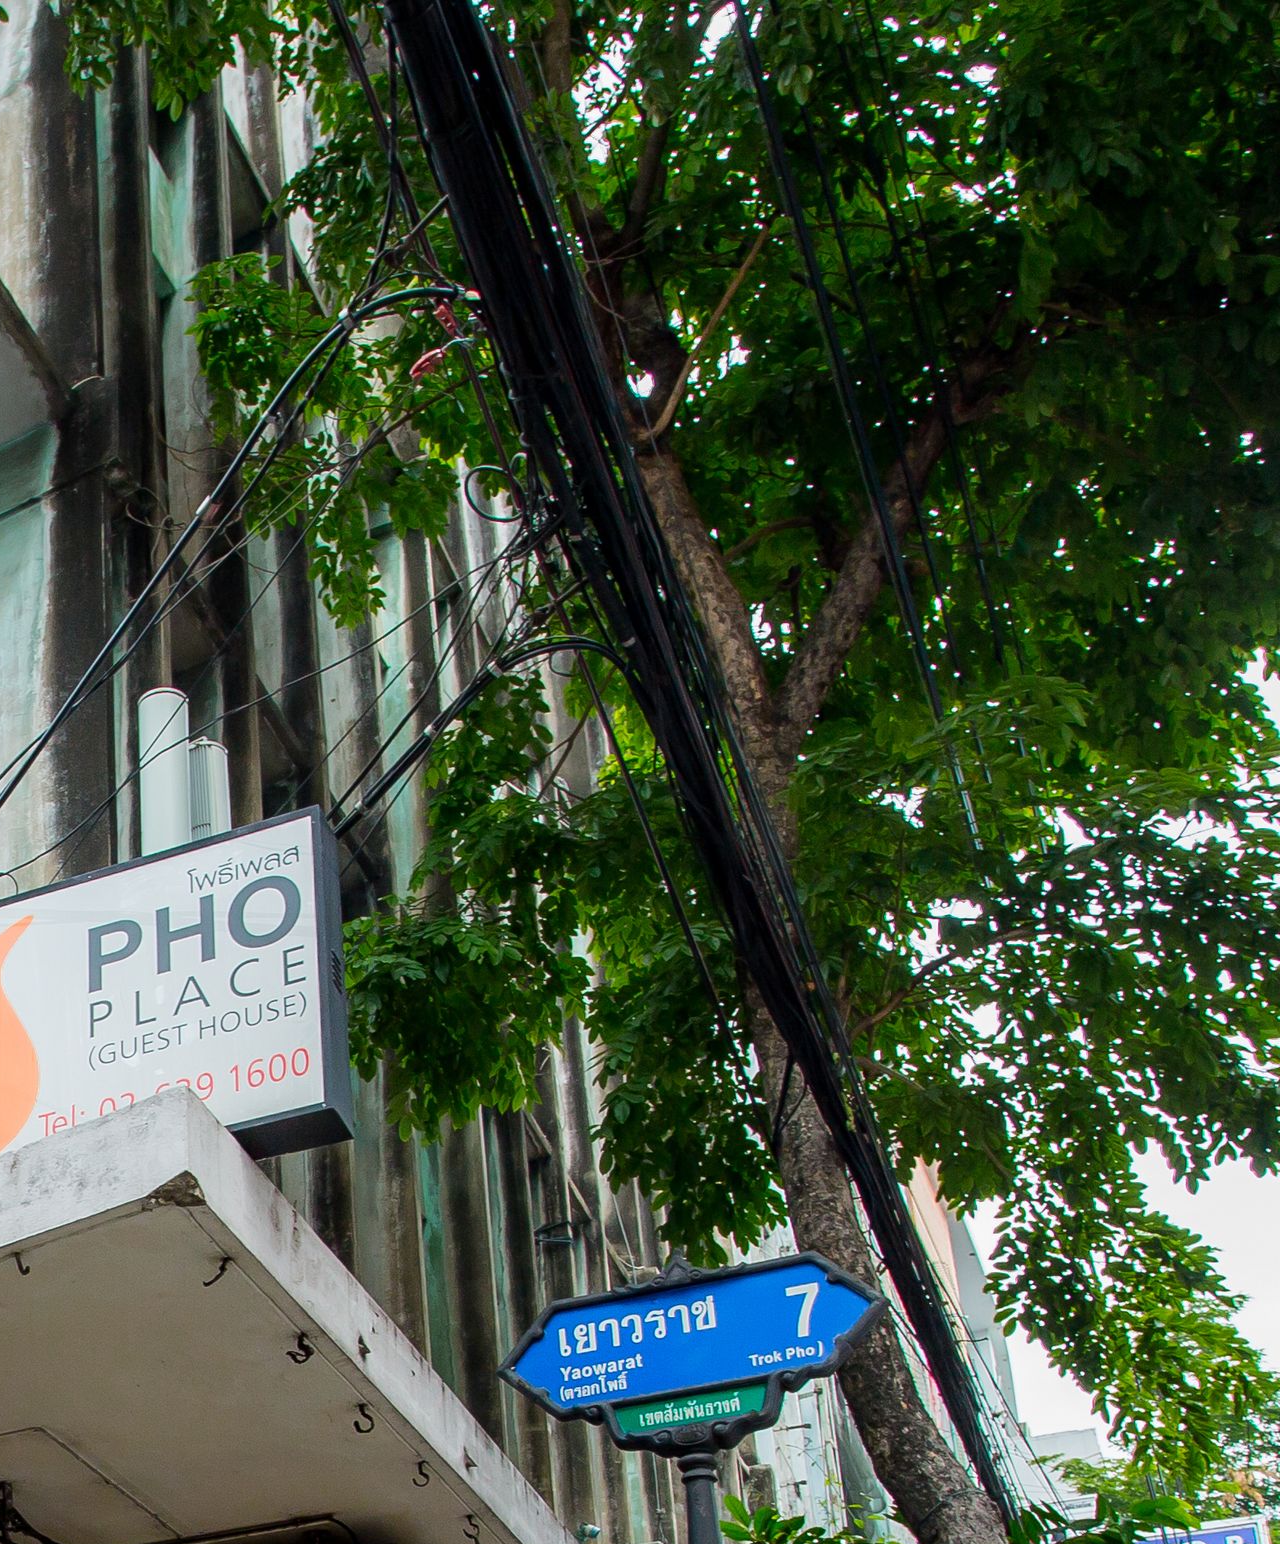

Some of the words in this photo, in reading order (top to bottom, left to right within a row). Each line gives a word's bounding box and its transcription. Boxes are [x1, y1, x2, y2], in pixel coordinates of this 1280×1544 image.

[87, 874, 302, 994] PHO
[88, 944, 307, 1039] PLACE
[87, 1023, 188, 1072] (GUEST
[198, 991, 308, 1041] HOUSE)
[228, 1046, 311, 1093] 1600
[557, 1294, 718, 1358] เยาวราช
[784, 1281, 819, 1339] 7
[559, 1353, 644, 1382] Yaowarat
[747, 1350, 782, 1367] Trok
[559, 1370, 629, 1402] (ตรอกโพธิ์
[639, 1391, 742, 1427] เขตสัมพันธวงศ์
